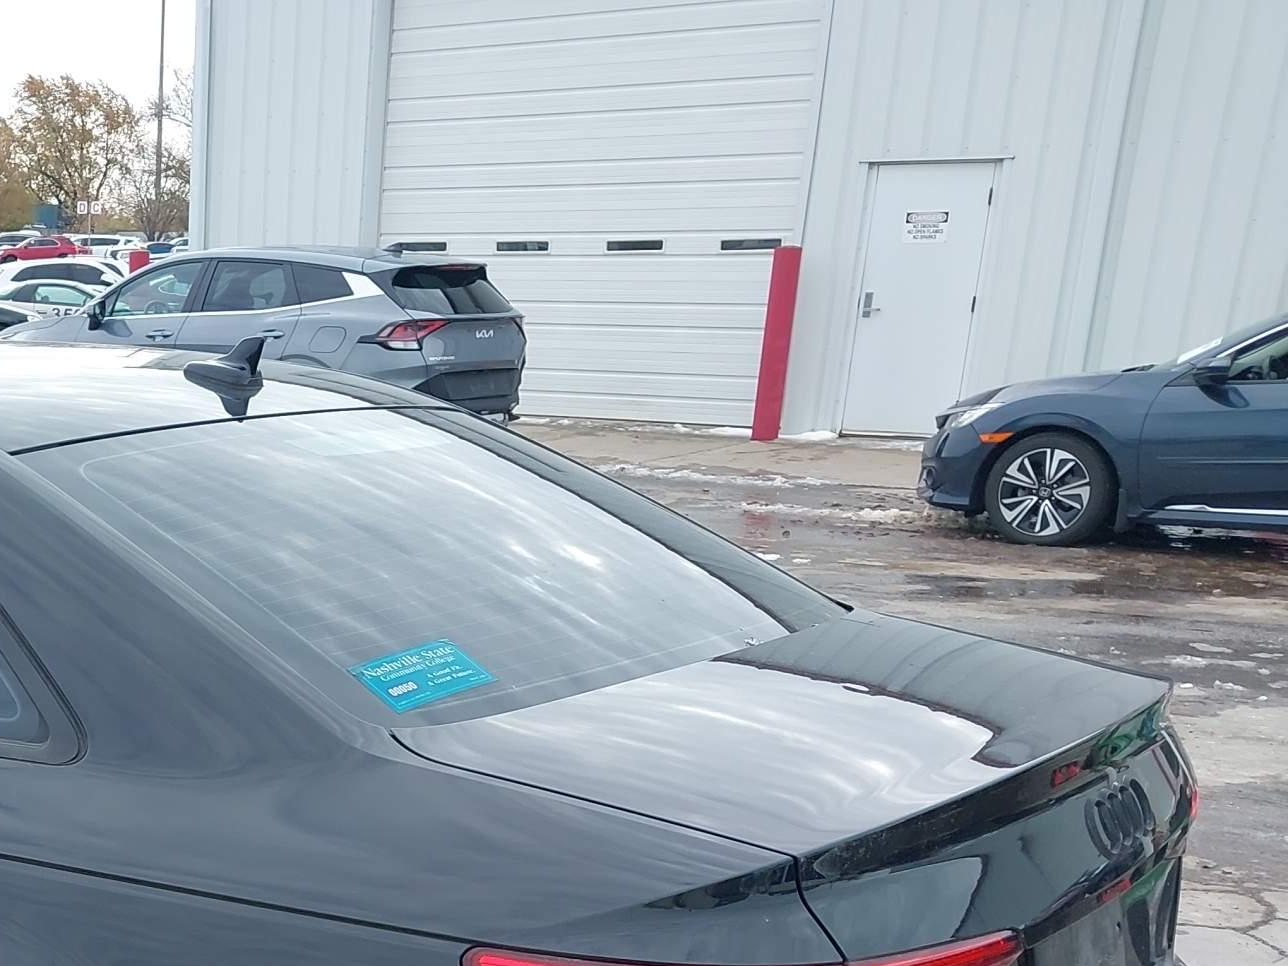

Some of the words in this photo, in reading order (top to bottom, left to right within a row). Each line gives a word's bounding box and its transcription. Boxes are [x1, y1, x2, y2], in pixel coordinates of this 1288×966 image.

[476, 329, 493, 338] KIA
[362, 654, 423, 679] Nashville
[421, 646, 455, 659] State
[387, 681, 418, 697] 00050
